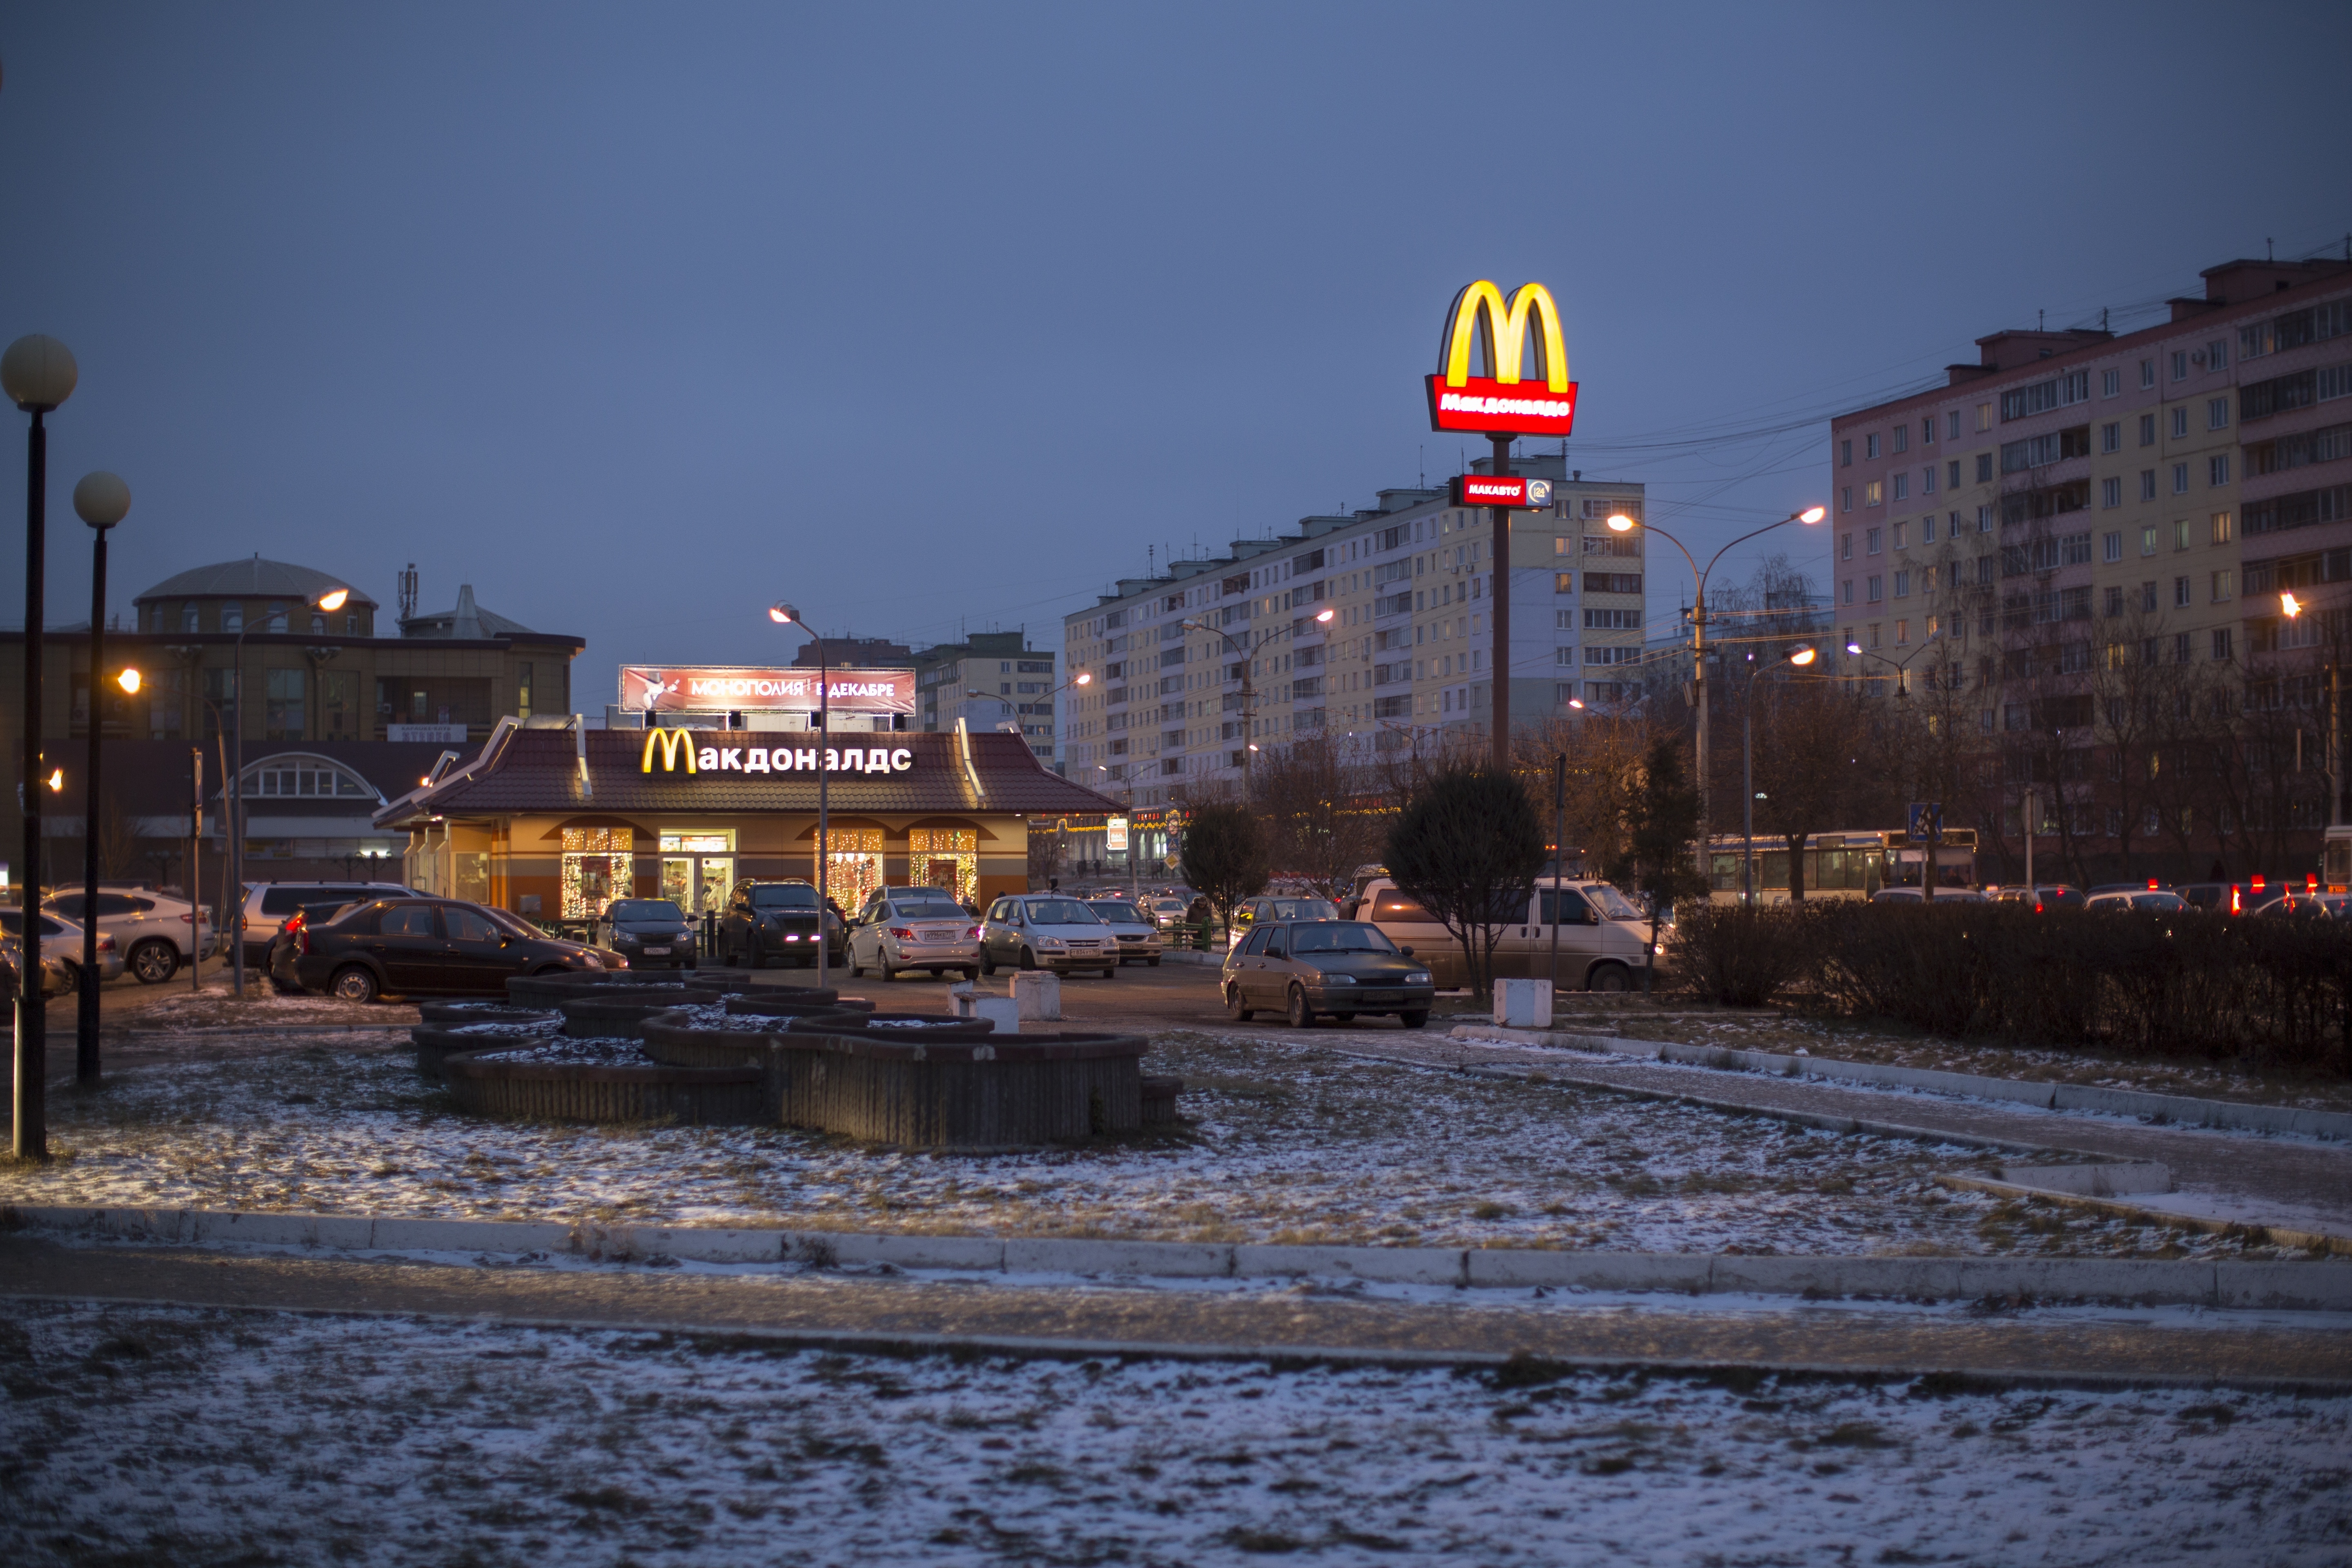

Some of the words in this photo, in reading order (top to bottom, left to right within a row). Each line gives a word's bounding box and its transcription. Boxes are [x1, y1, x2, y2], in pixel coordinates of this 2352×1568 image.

[1441, 393, 1570, 417] Макдоналдс
[1469, 484, 1520, 497] МАКАВТО
[691, 676, 804, 697] МОНОПОЛИЯ
[829, 682, 895, 698] ДЕКАБРЕ
